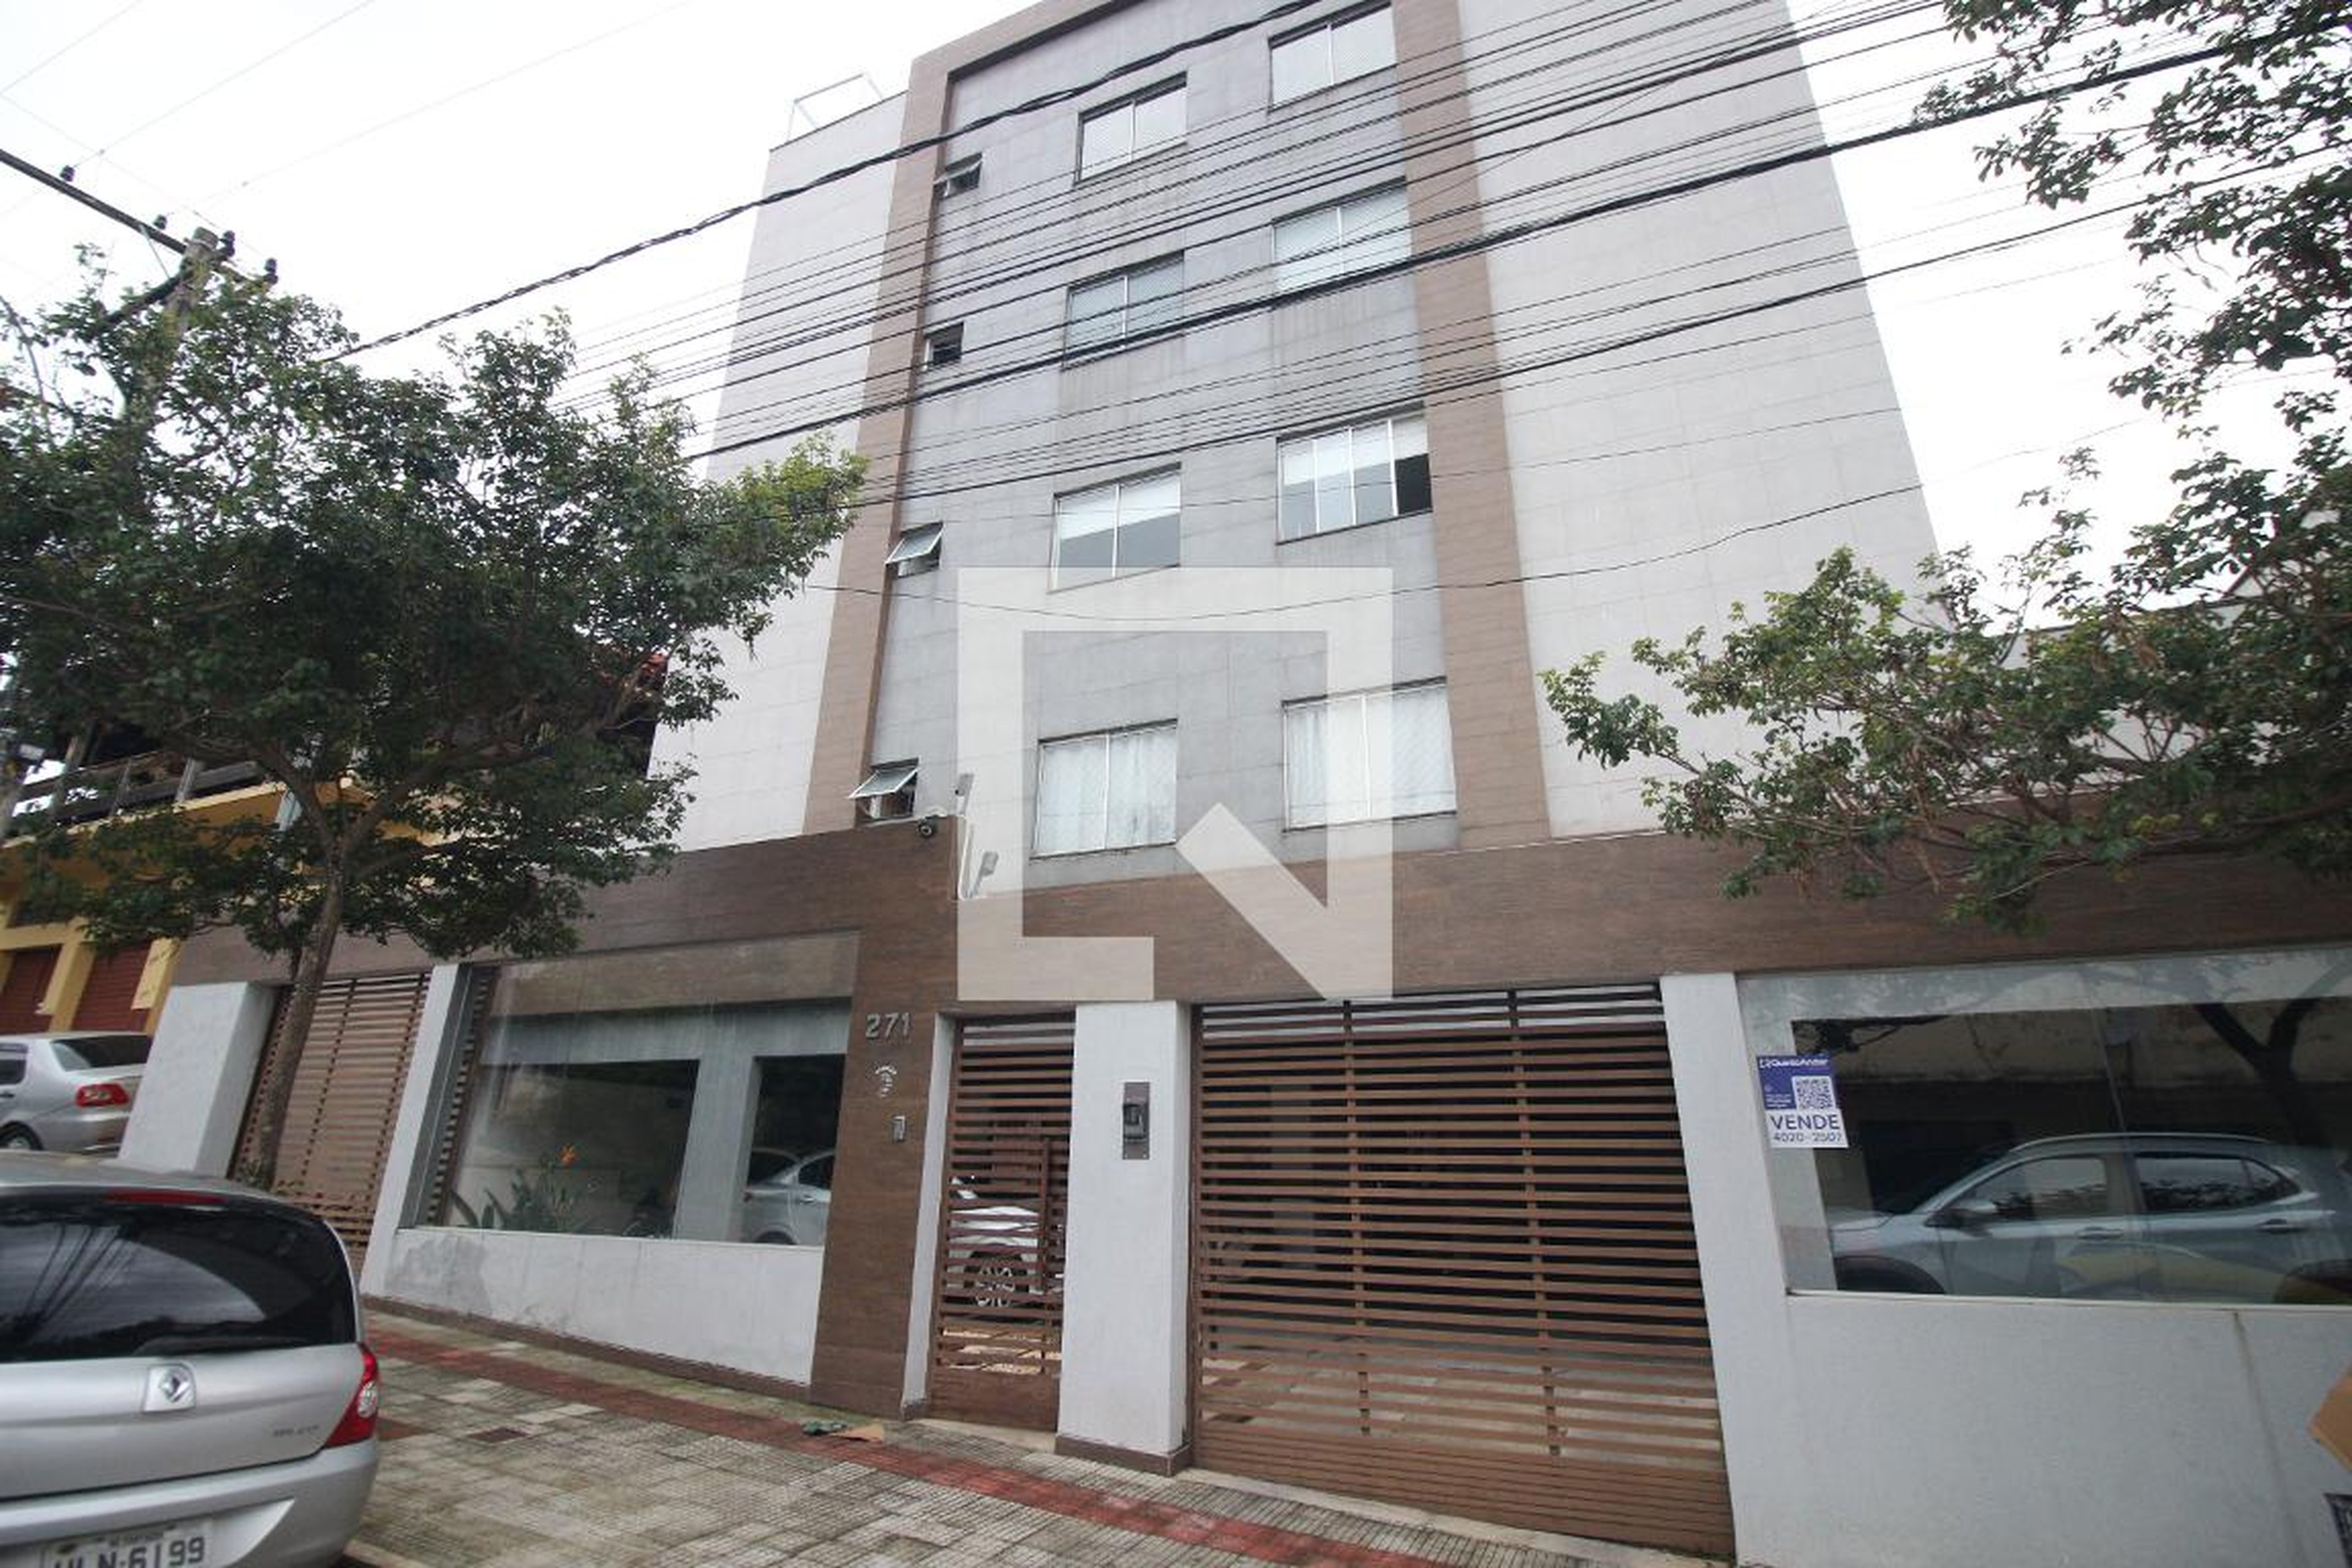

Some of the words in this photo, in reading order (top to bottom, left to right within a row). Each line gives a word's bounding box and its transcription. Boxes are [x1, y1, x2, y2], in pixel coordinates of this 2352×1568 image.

[865, 1012, 910, 1039] 271
[1770, 1114, 1840, 1130] VENDE
[55, 1536, 206, 1568] N-6199
